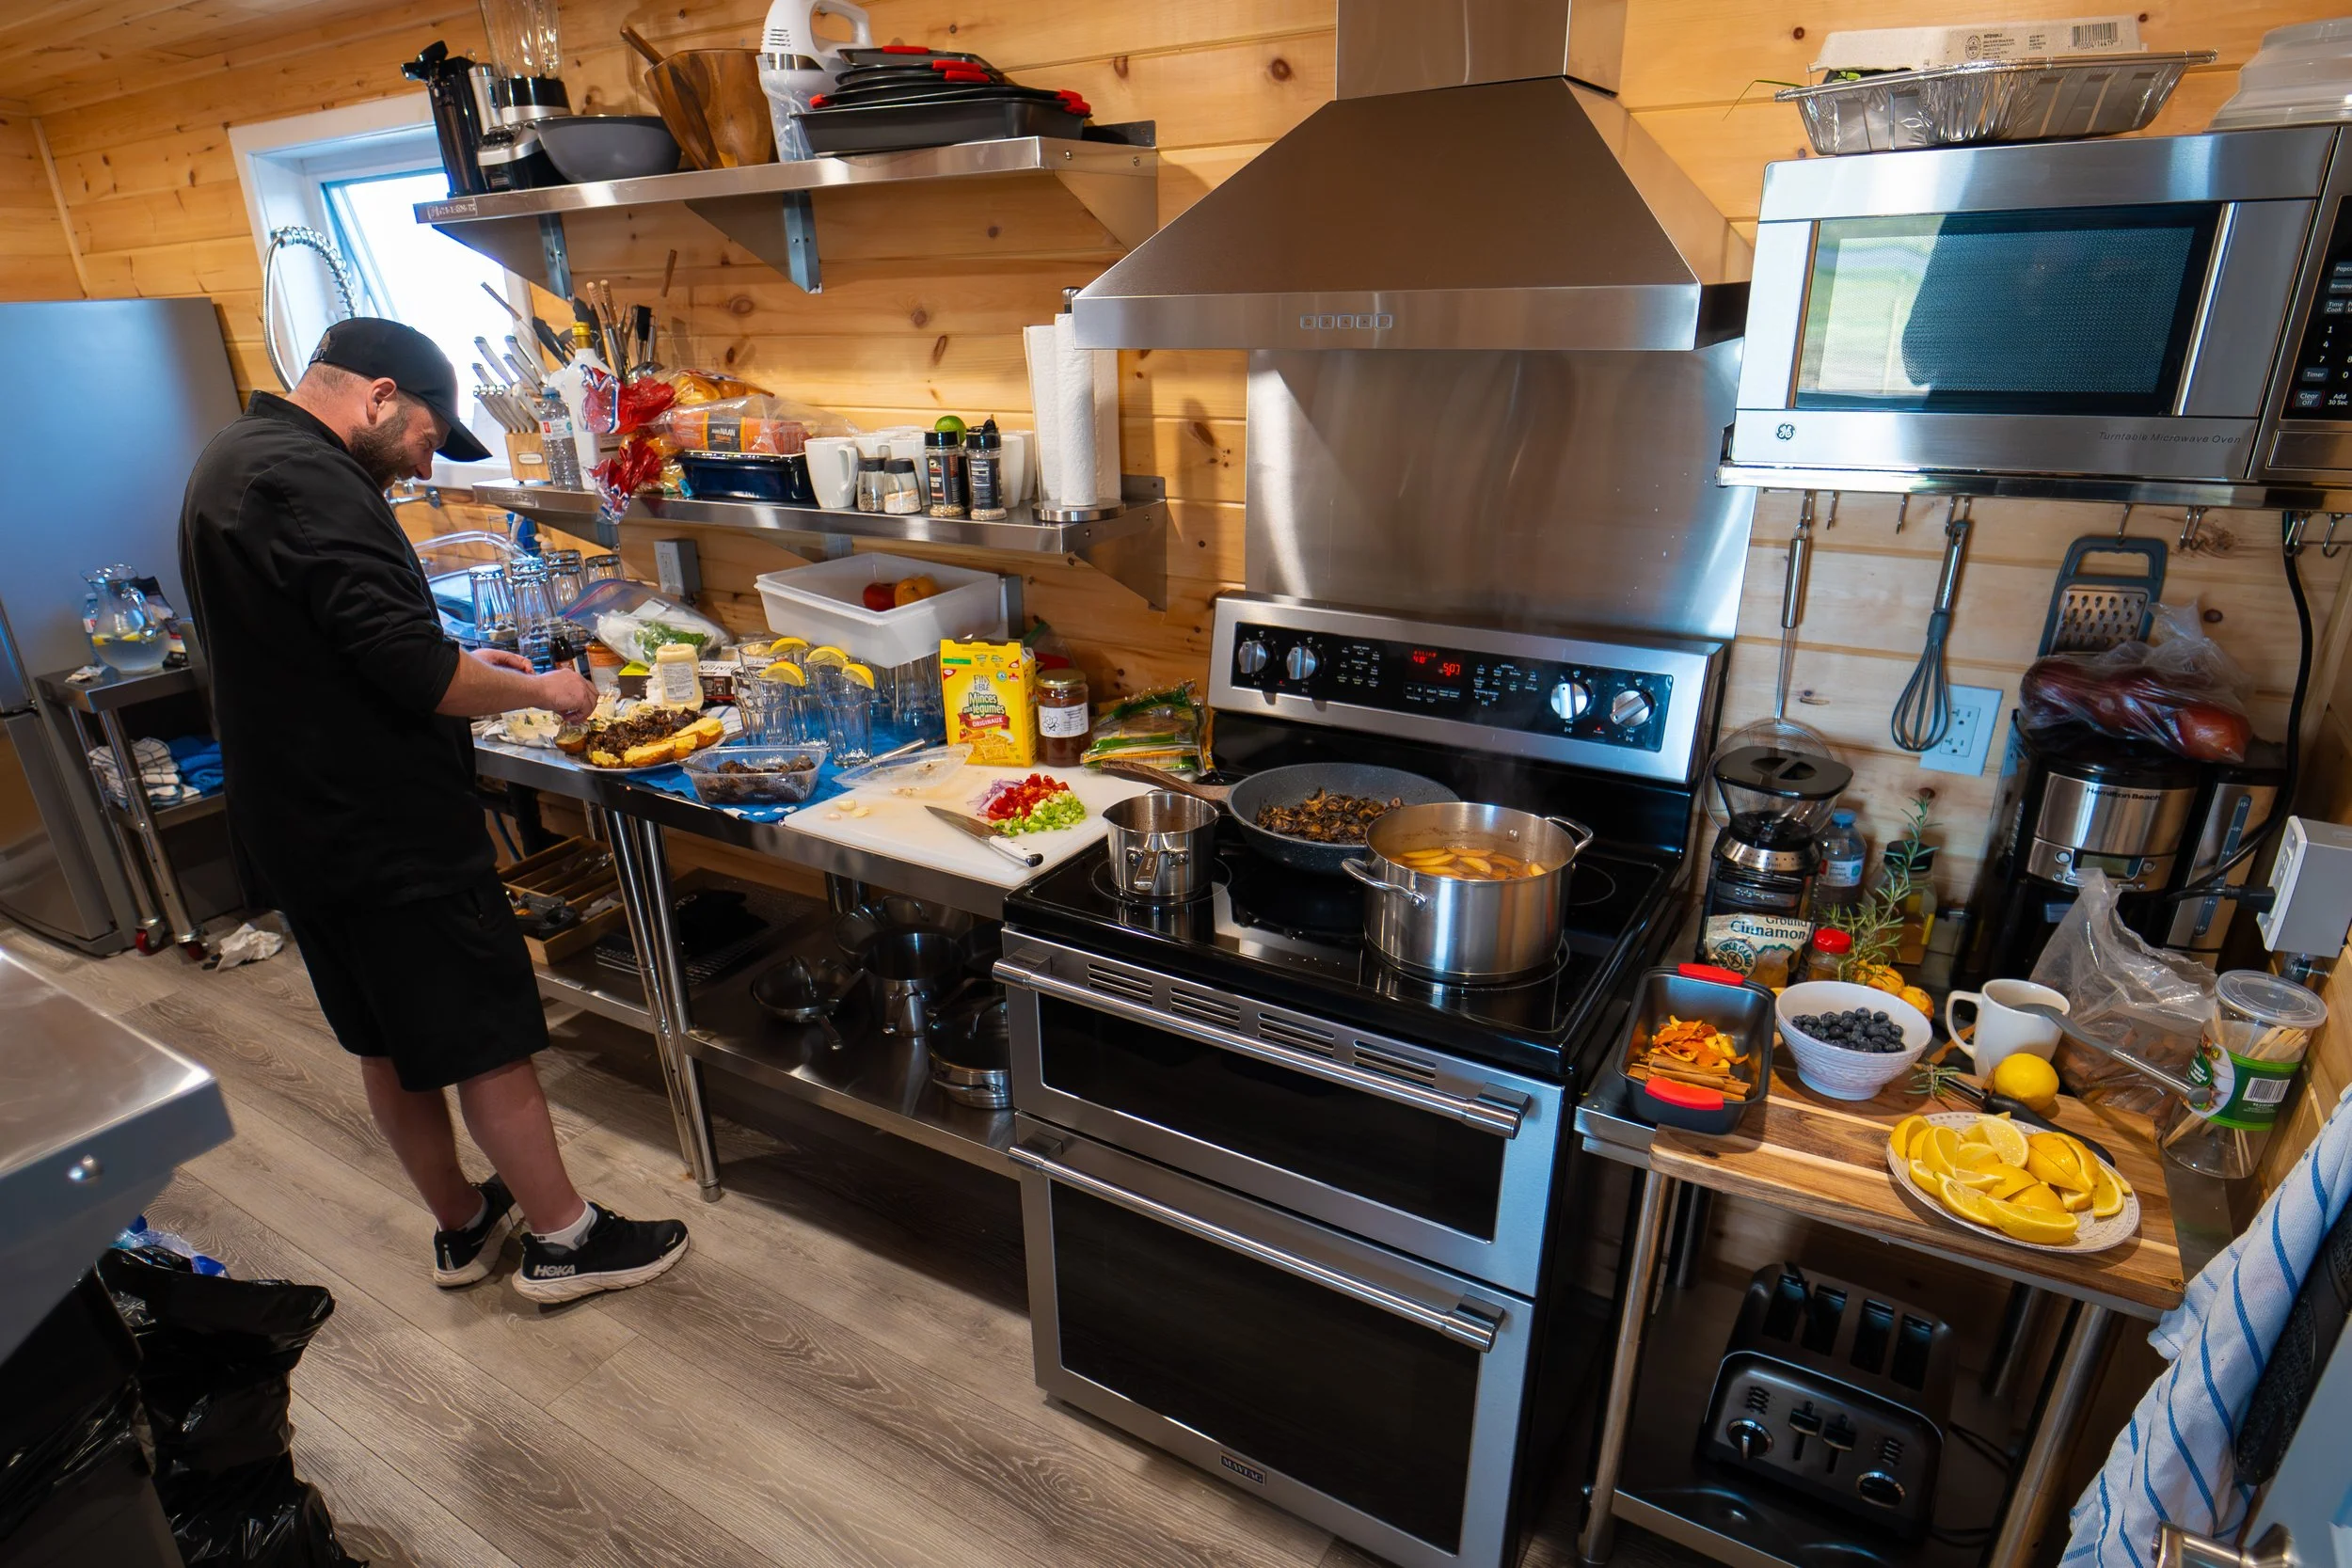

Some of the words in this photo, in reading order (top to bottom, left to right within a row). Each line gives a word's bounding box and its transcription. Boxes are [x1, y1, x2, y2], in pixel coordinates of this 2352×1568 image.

[2327, 325, 2333, 334] 1
[2319, 355, 2326, 363] 7
[2099, 431, 2148, 442] Turntable
[2150, 433, 2209, 444] Microwave
[2211, 435, 2242, 444] Oven
[968, 691, 997, 705] Minces
[2086, 787, 2131, 800] Hamilton
[1766, 916, 1807, 928] Ground
[1730, 920, 1806, 940] Cinnamon
[533, 1264, 576, 1277] HOKA
[1223, 1457, 1263, 1482] MAYTAG
